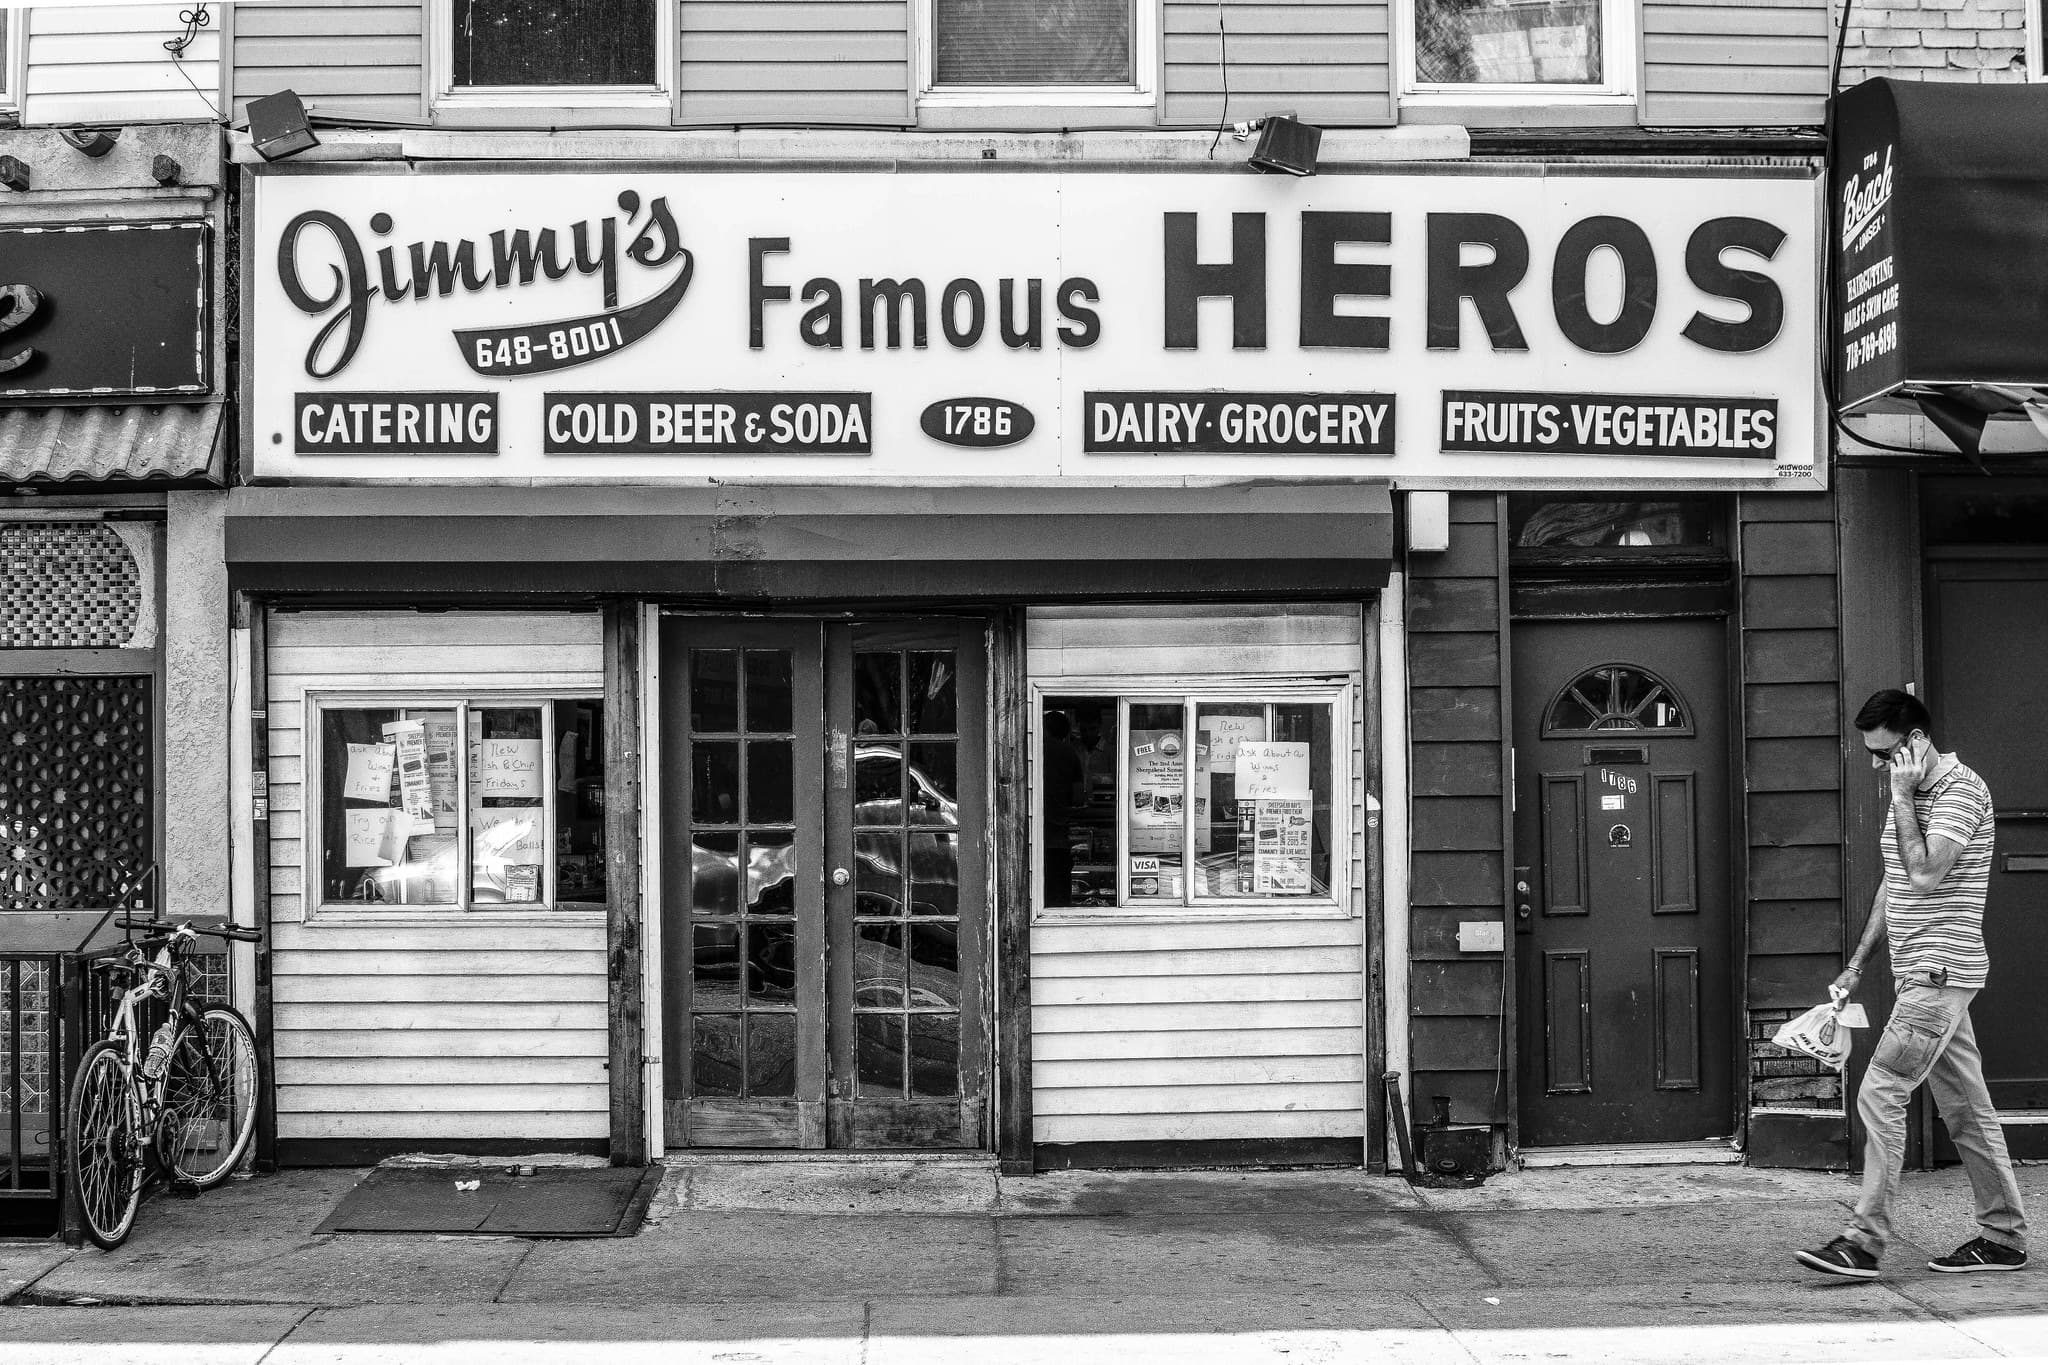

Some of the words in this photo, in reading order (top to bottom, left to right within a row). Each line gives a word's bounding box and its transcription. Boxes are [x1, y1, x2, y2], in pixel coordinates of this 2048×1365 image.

[1843, 144, 1892, 236] Beach
[1859, 216, 1882, 251] UNISEX
[277, 189, 693, 380] Jimmy's
[749, 236, 1101, 350] Famous
[1163, 211, 1788, 354] HEROS
[1847, 256, 1893, 302] HAIRCUTTING
[1843, 304, 1861, 334] NAILS
[1866, 293, 1882, 322] SKIN
[1882, 283, 1899, 313] CARE
[476, 318, 624, 368] 648-8001
[1846, 321, 1897, 372] 718-769-6198
[301, 402, 493, 445] CATERING
[548, 402, 638, 445] COLD
[653, 402, 735, 444] BEER
[944, 405, 1012, 436] 1786
[1136, 745, 1153, 755] FREE
[1602, 769, 1637, 794] 1786
[1134, 861, 1157, 870] VISA
